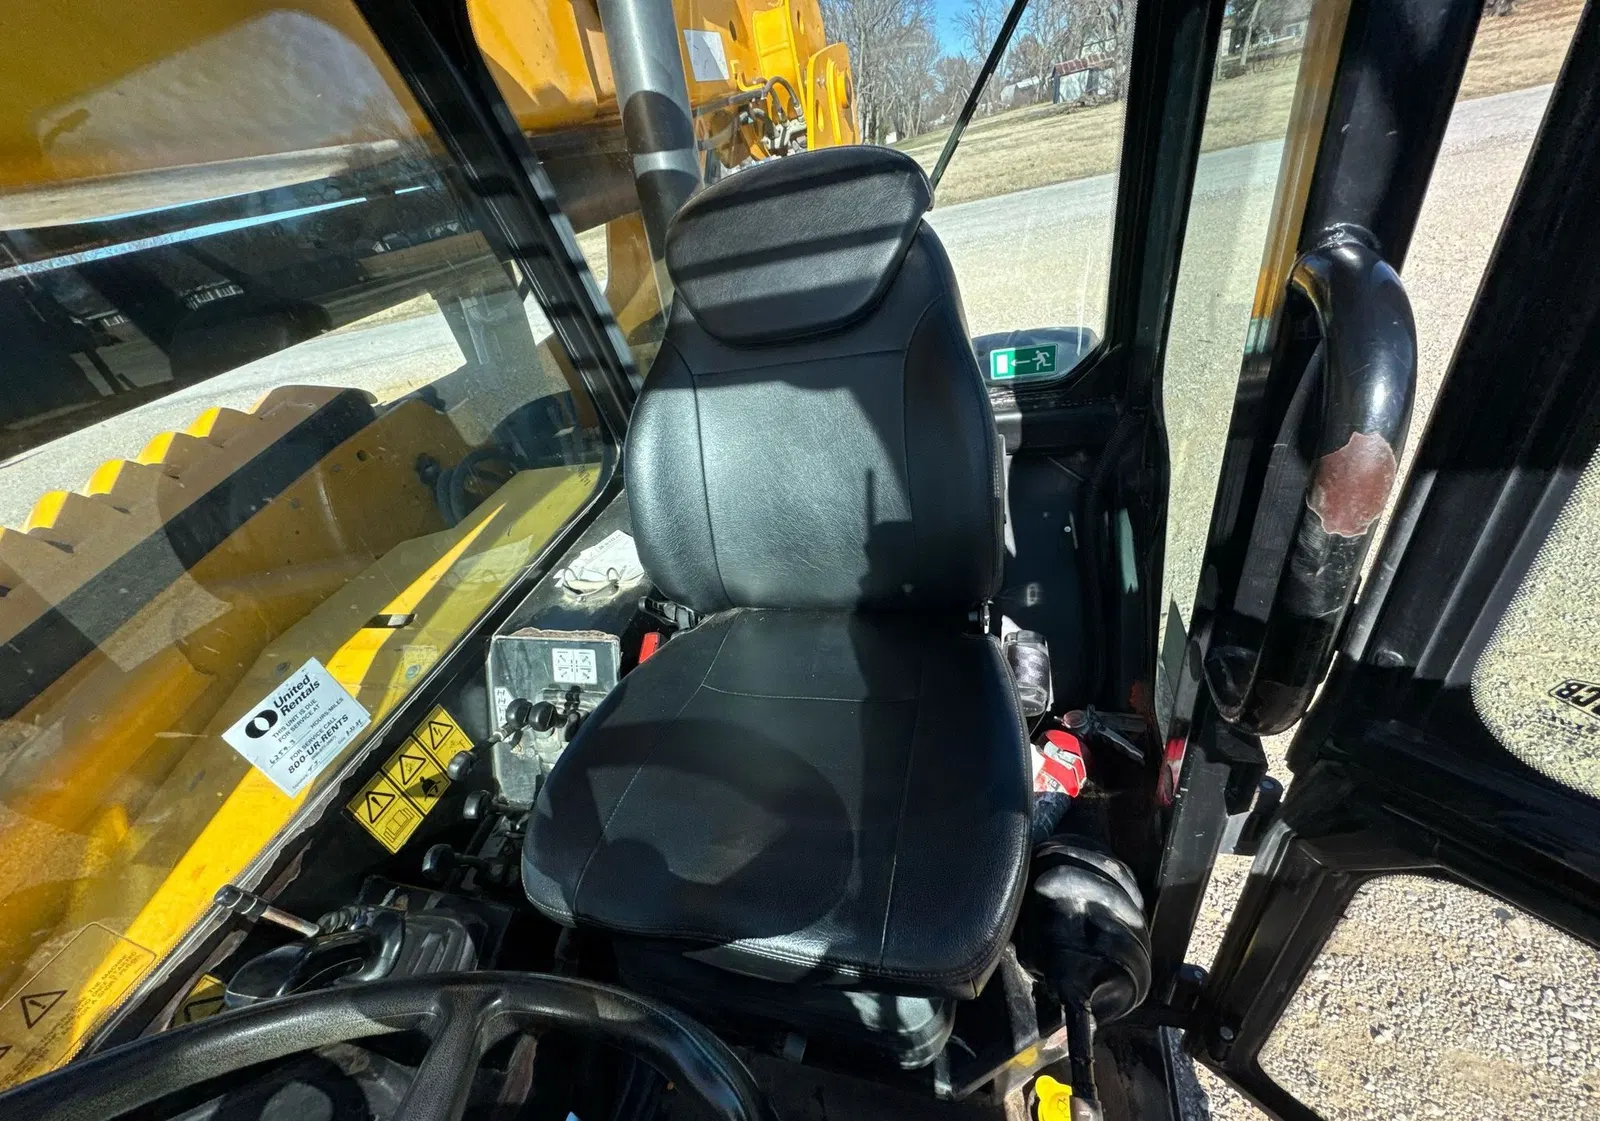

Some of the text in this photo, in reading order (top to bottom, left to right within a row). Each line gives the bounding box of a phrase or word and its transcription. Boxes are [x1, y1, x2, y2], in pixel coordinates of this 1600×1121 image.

[272, 673, 311, 709] United
[278, 678, 321, 716] Rentals
[271, 697, 317, 739] THIS UNIT IS DUE
[277, 703, 321, 743] FOR SERVICE AT
[289, 715, 337, 761] FOR SERVICE CALL
[286, 713, 349, 774] 800-UR-RENTS
